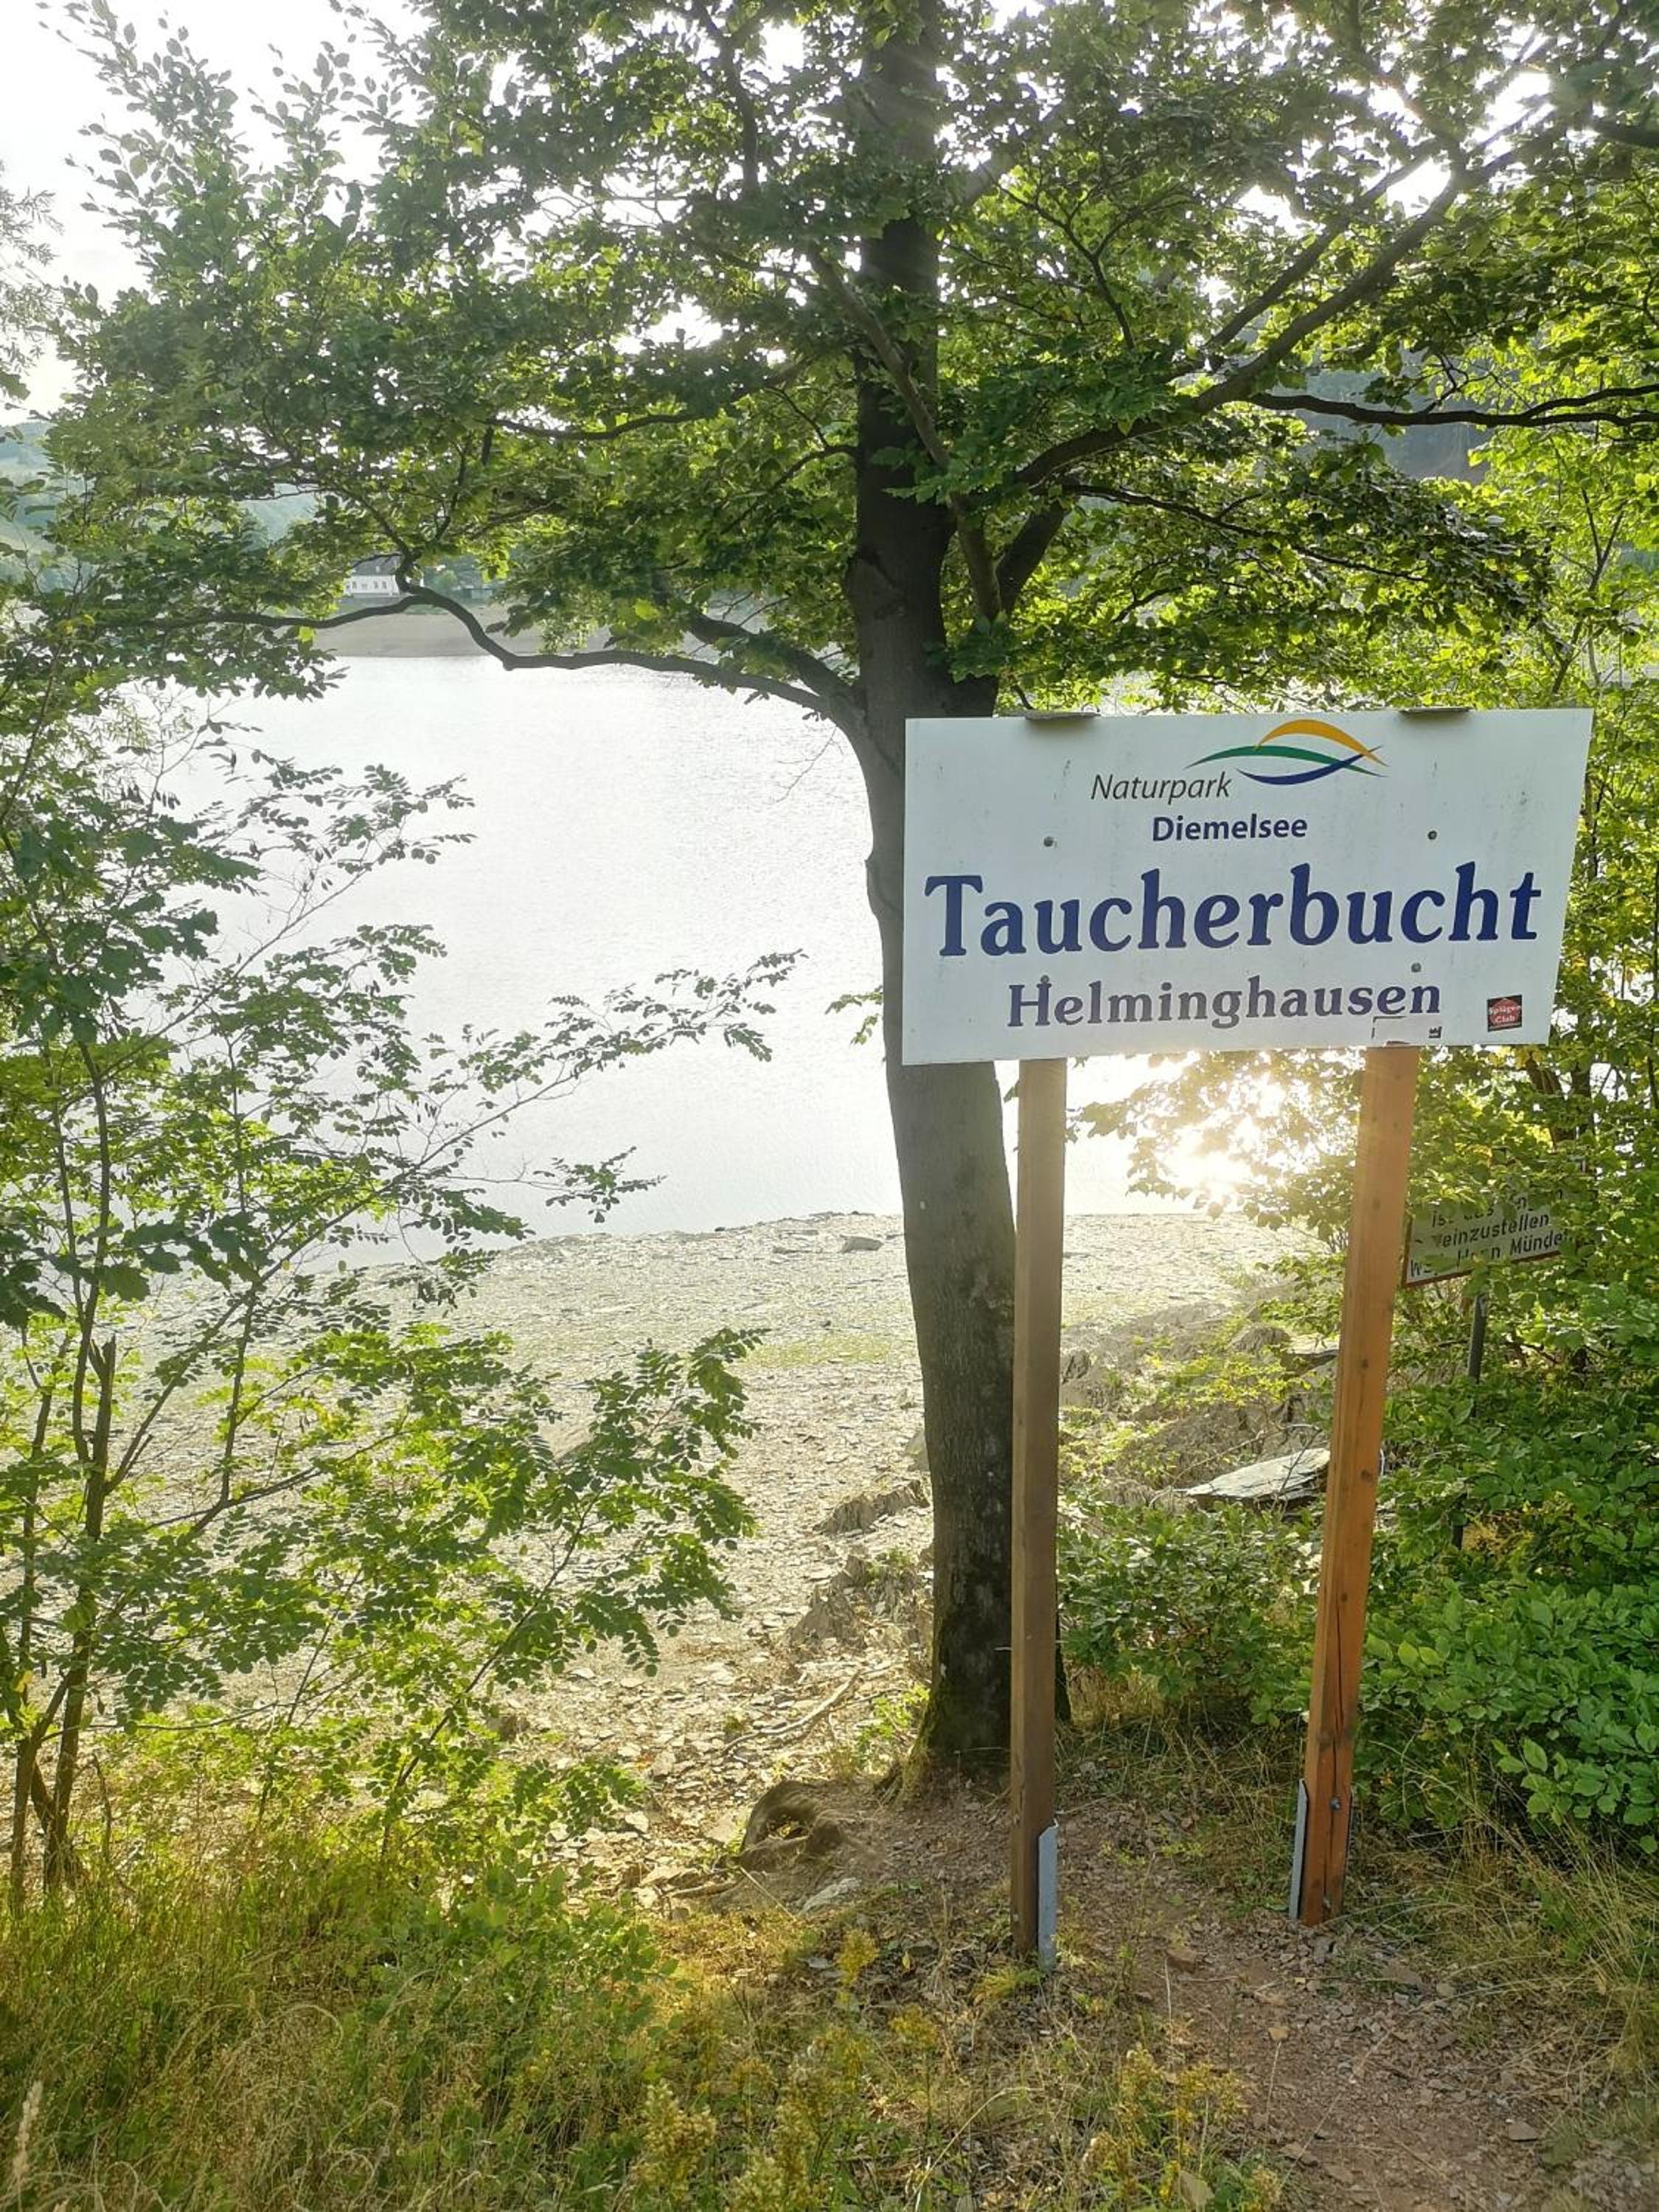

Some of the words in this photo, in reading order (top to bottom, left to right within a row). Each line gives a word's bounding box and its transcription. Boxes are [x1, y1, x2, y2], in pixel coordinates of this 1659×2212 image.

[1091, 771, 1232, 806] Naturpark
[1153, 813, 1308, 842] Diemelsee
[925, 860, 1542, 957] Taucherbucht
[1008, 975, 1440, 1029] Helminghausen
[1442, 1213, 1550, 1248] einzustellen
